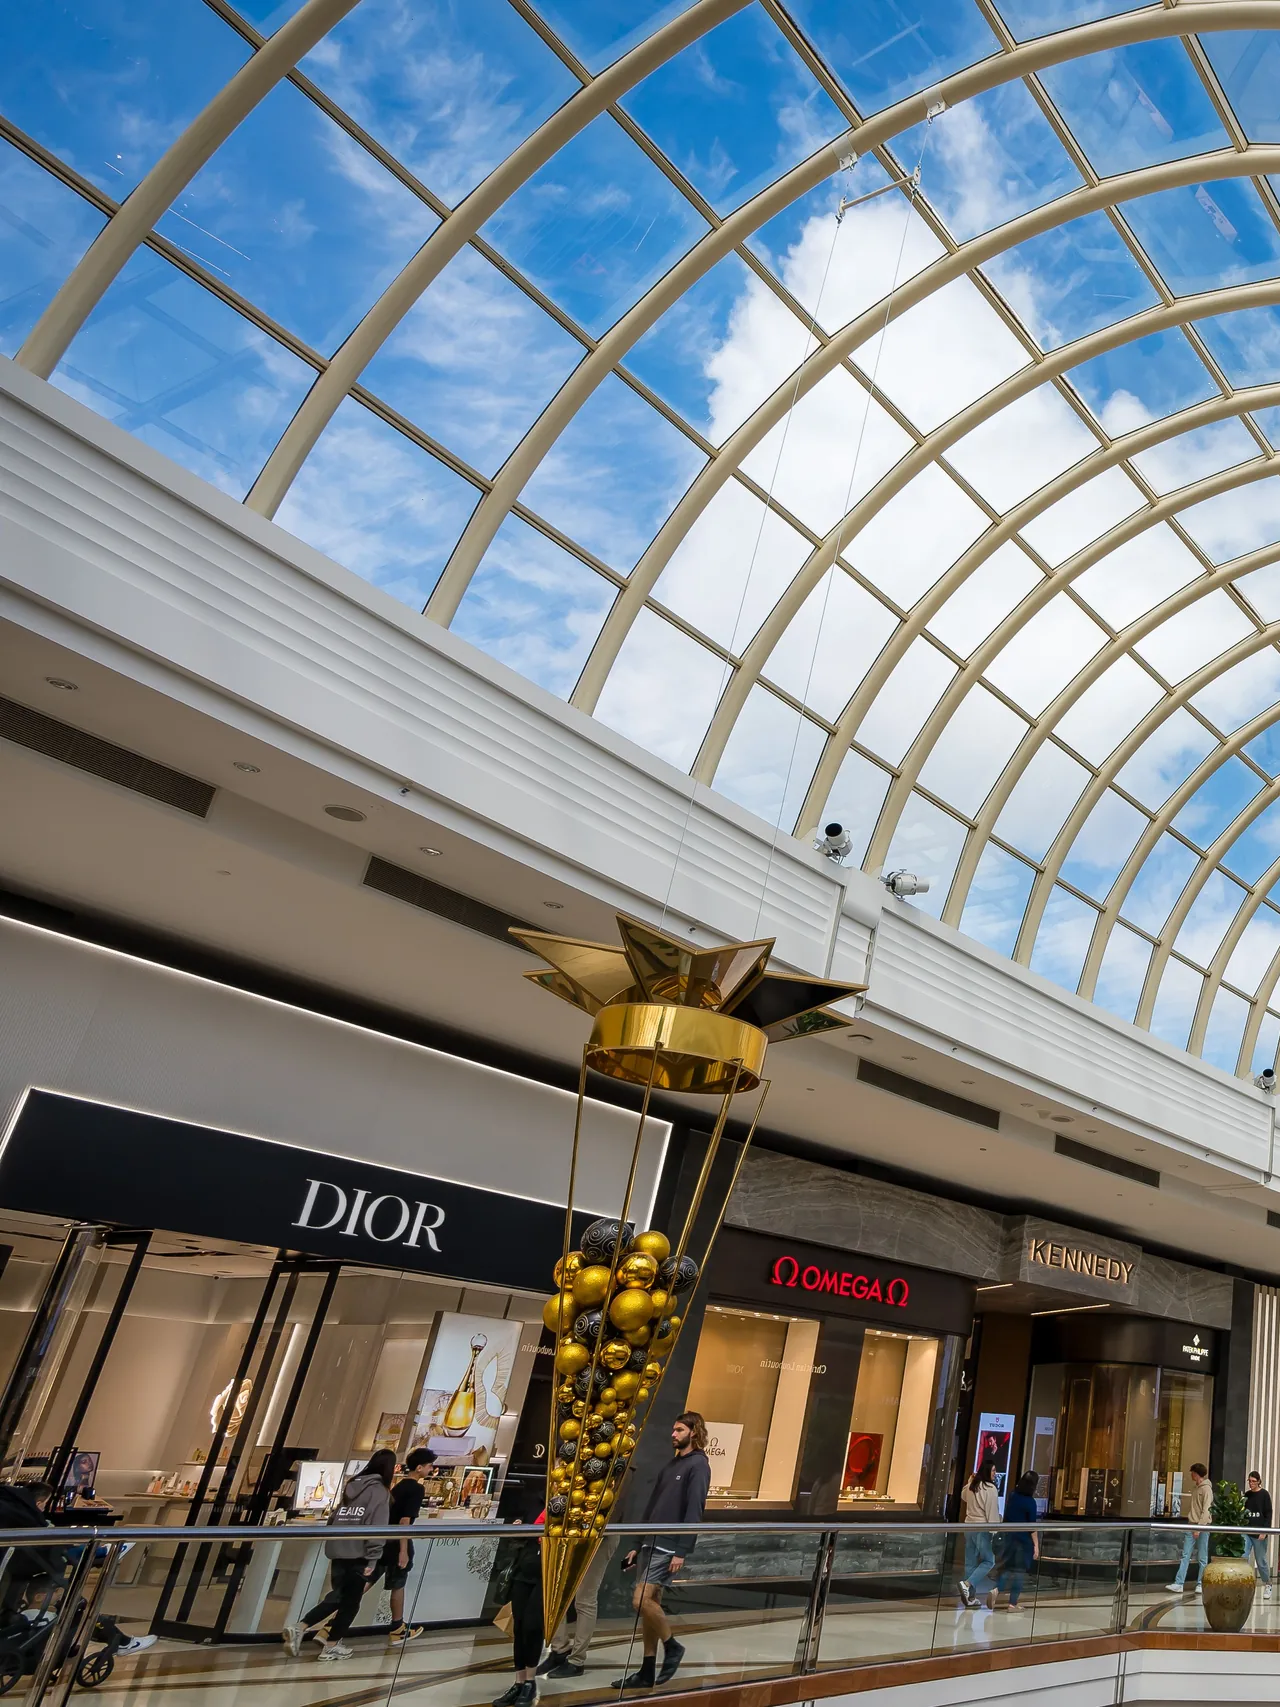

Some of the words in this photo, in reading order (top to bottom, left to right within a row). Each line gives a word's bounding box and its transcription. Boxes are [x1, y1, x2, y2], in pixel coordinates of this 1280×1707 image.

[291, 1178, 446, 1252] DIOR
[1030, 1238, 1136, 1284] KENNEDY
[801, 1265, 883, 1302] OMEGA
[436, 1538, 461, 1547] DIOR
